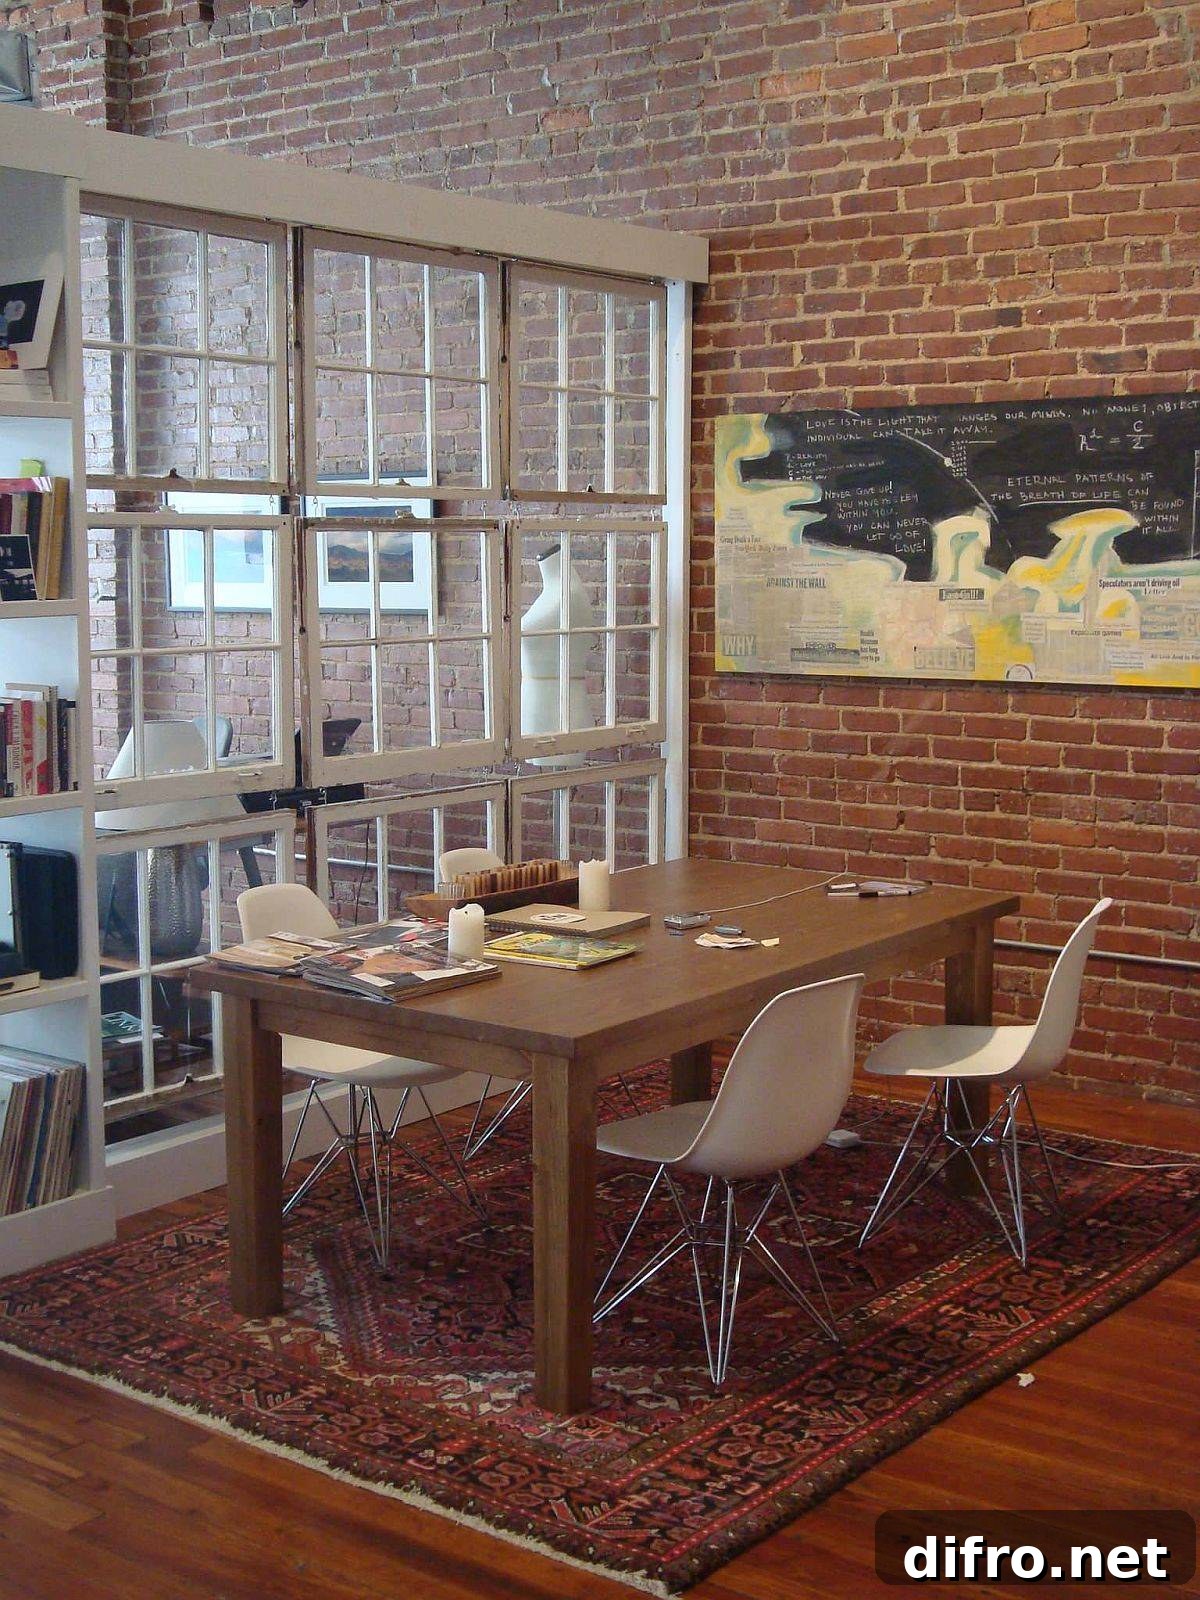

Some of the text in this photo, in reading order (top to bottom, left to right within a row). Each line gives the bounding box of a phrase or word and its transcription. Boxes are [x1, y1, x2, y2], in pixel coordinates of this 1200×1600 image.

[806, 418, 835, 430] LOVE
[852, 417, 873, 427] THE
[878, 415, 912, 427] LIGHT
[917, 414, 938, 425] THAT
[1005, 410, 1027, 420] OUR
[806, 433, 863, 444] INDIVIDUAL
[903, 427, 933, 437] TAKE
[1007, 472, 1154, 487] ETERNAL PATTERNS OF
[824, 490, 851, 500] NEVER
[856, 487, 876, 496] GIVE
[991, 487, 1150, 501] THE BREATH OF LIFE CAN
[836, 501, 853, 512] YOU
[857, 498, 879, 507] HAVE
[1131, 499, 1185, 511] BE FOUND
[837, 509, 869, 520] WITHIN
[1144, 514, 1179, 523] WITHIN
[846, 517, 929, 533] YOU CAN NEVER
[866, 532, 886, 542] LET
[905, 530, 920, 539] OF
[895, 538, 926, 554] LOVE!
[766, 577, 827, 589] AGAINST THE WALL
[1098, 578, 1180, 589] Speculators aren't driving oil
[723, 635, 756, 656] WHY
